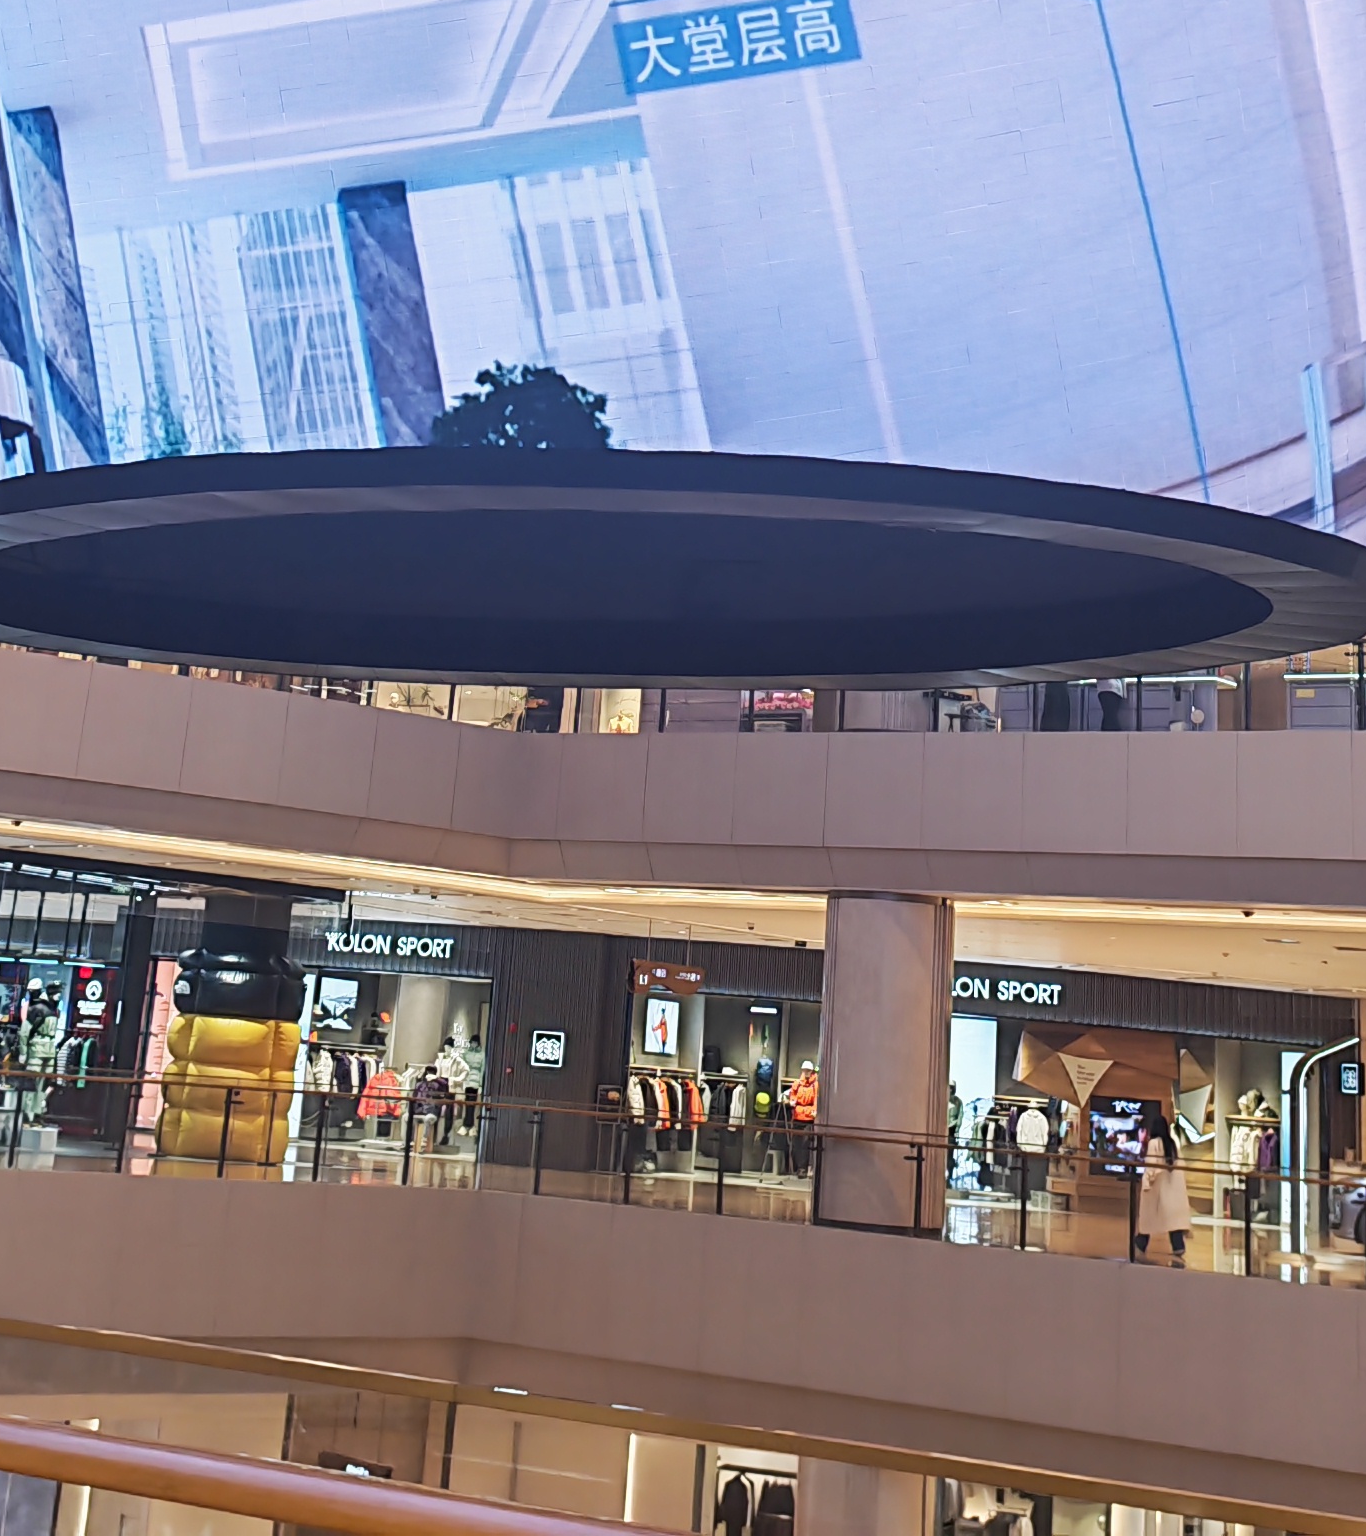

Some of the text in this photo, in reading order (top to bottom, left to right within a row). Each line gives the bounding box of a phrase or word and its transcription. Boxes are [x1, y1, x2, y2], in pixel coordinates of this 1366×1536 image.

[325, 932, 455, 959] KOLON SPORT
[997, 980, 1062, 1005] SPORT
